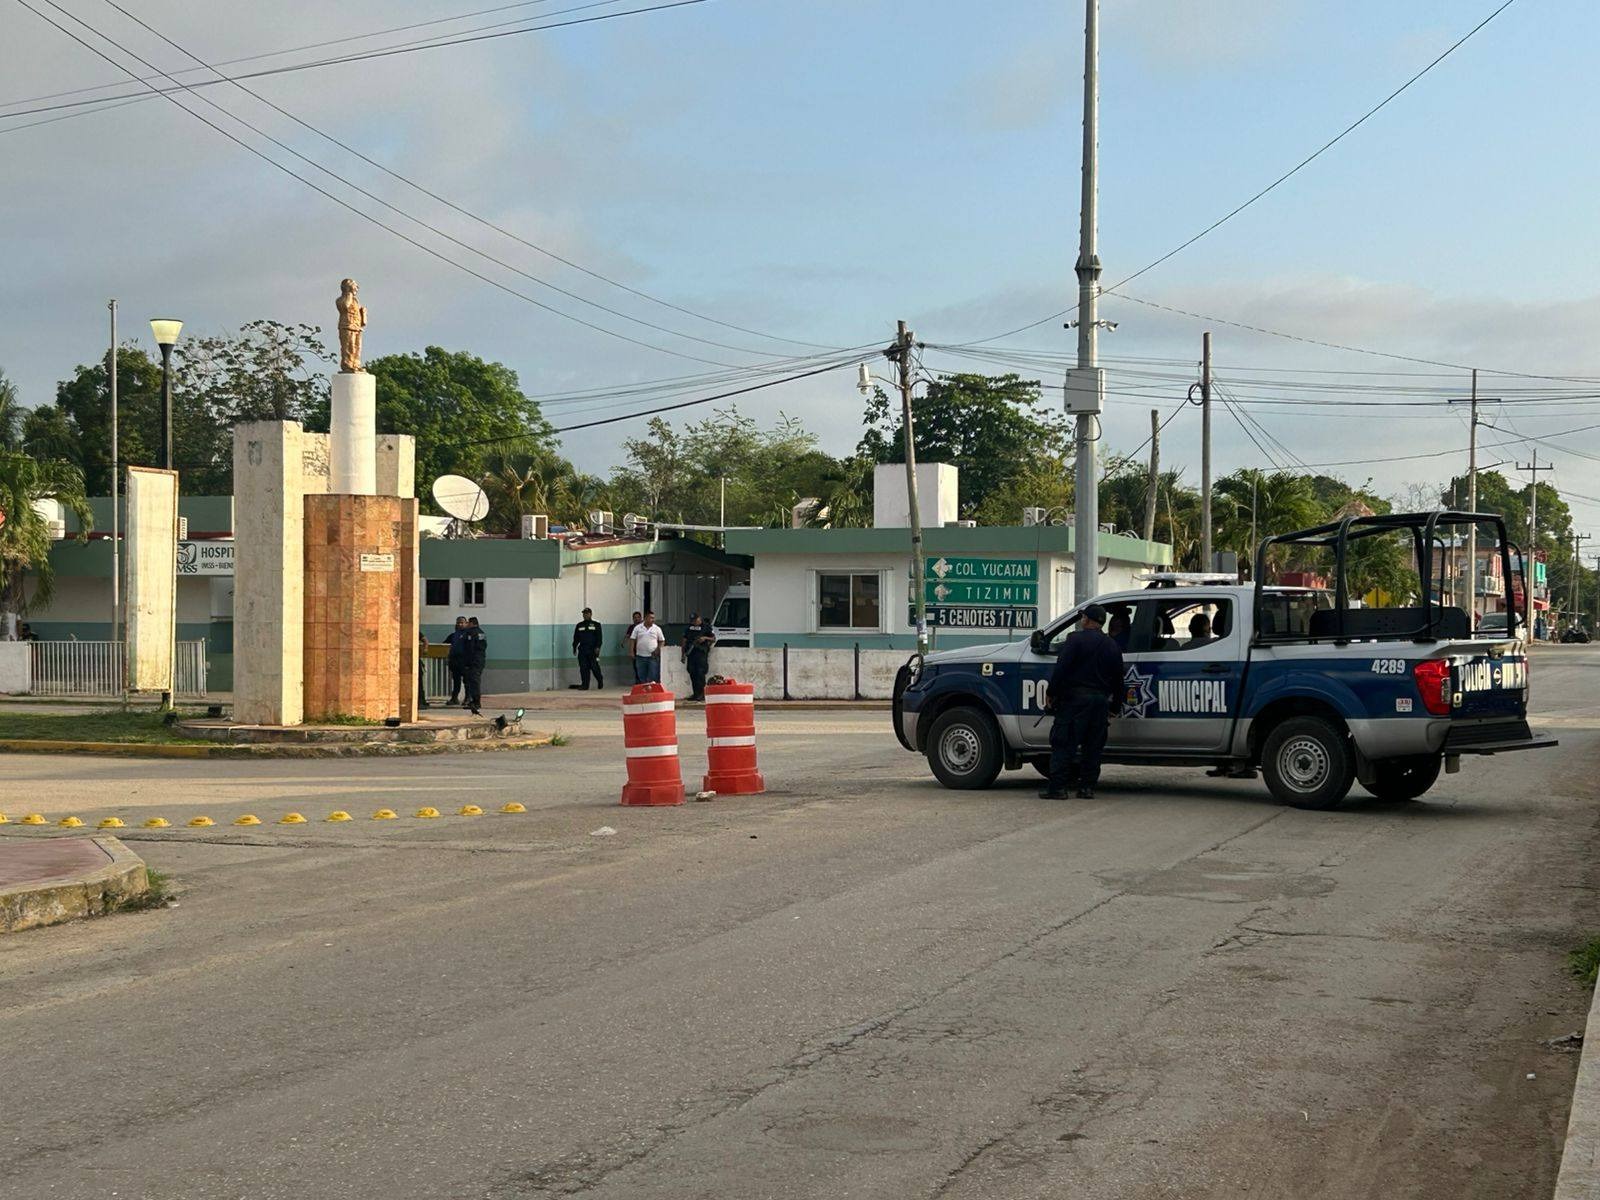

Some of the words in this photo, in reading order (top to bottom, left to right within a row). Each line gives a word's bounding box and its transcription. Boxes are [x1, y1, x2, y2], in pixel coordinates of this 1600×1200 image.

[956, 562, 977, 576] COL
[982, 563, 1031, 577] YUCATAN
[966, 586, 1031, 600] TIZIMIN
[940, 609, 946, 625] 5
[949, 609, 996, 626] CENOTES
[1000, 611, 1013, 626] 17
[1015, 610, 1033, 627] KM
[1371, 659, 1406, 674] 4289
[1158, 679, 1227, 713] MUNICIPAL
